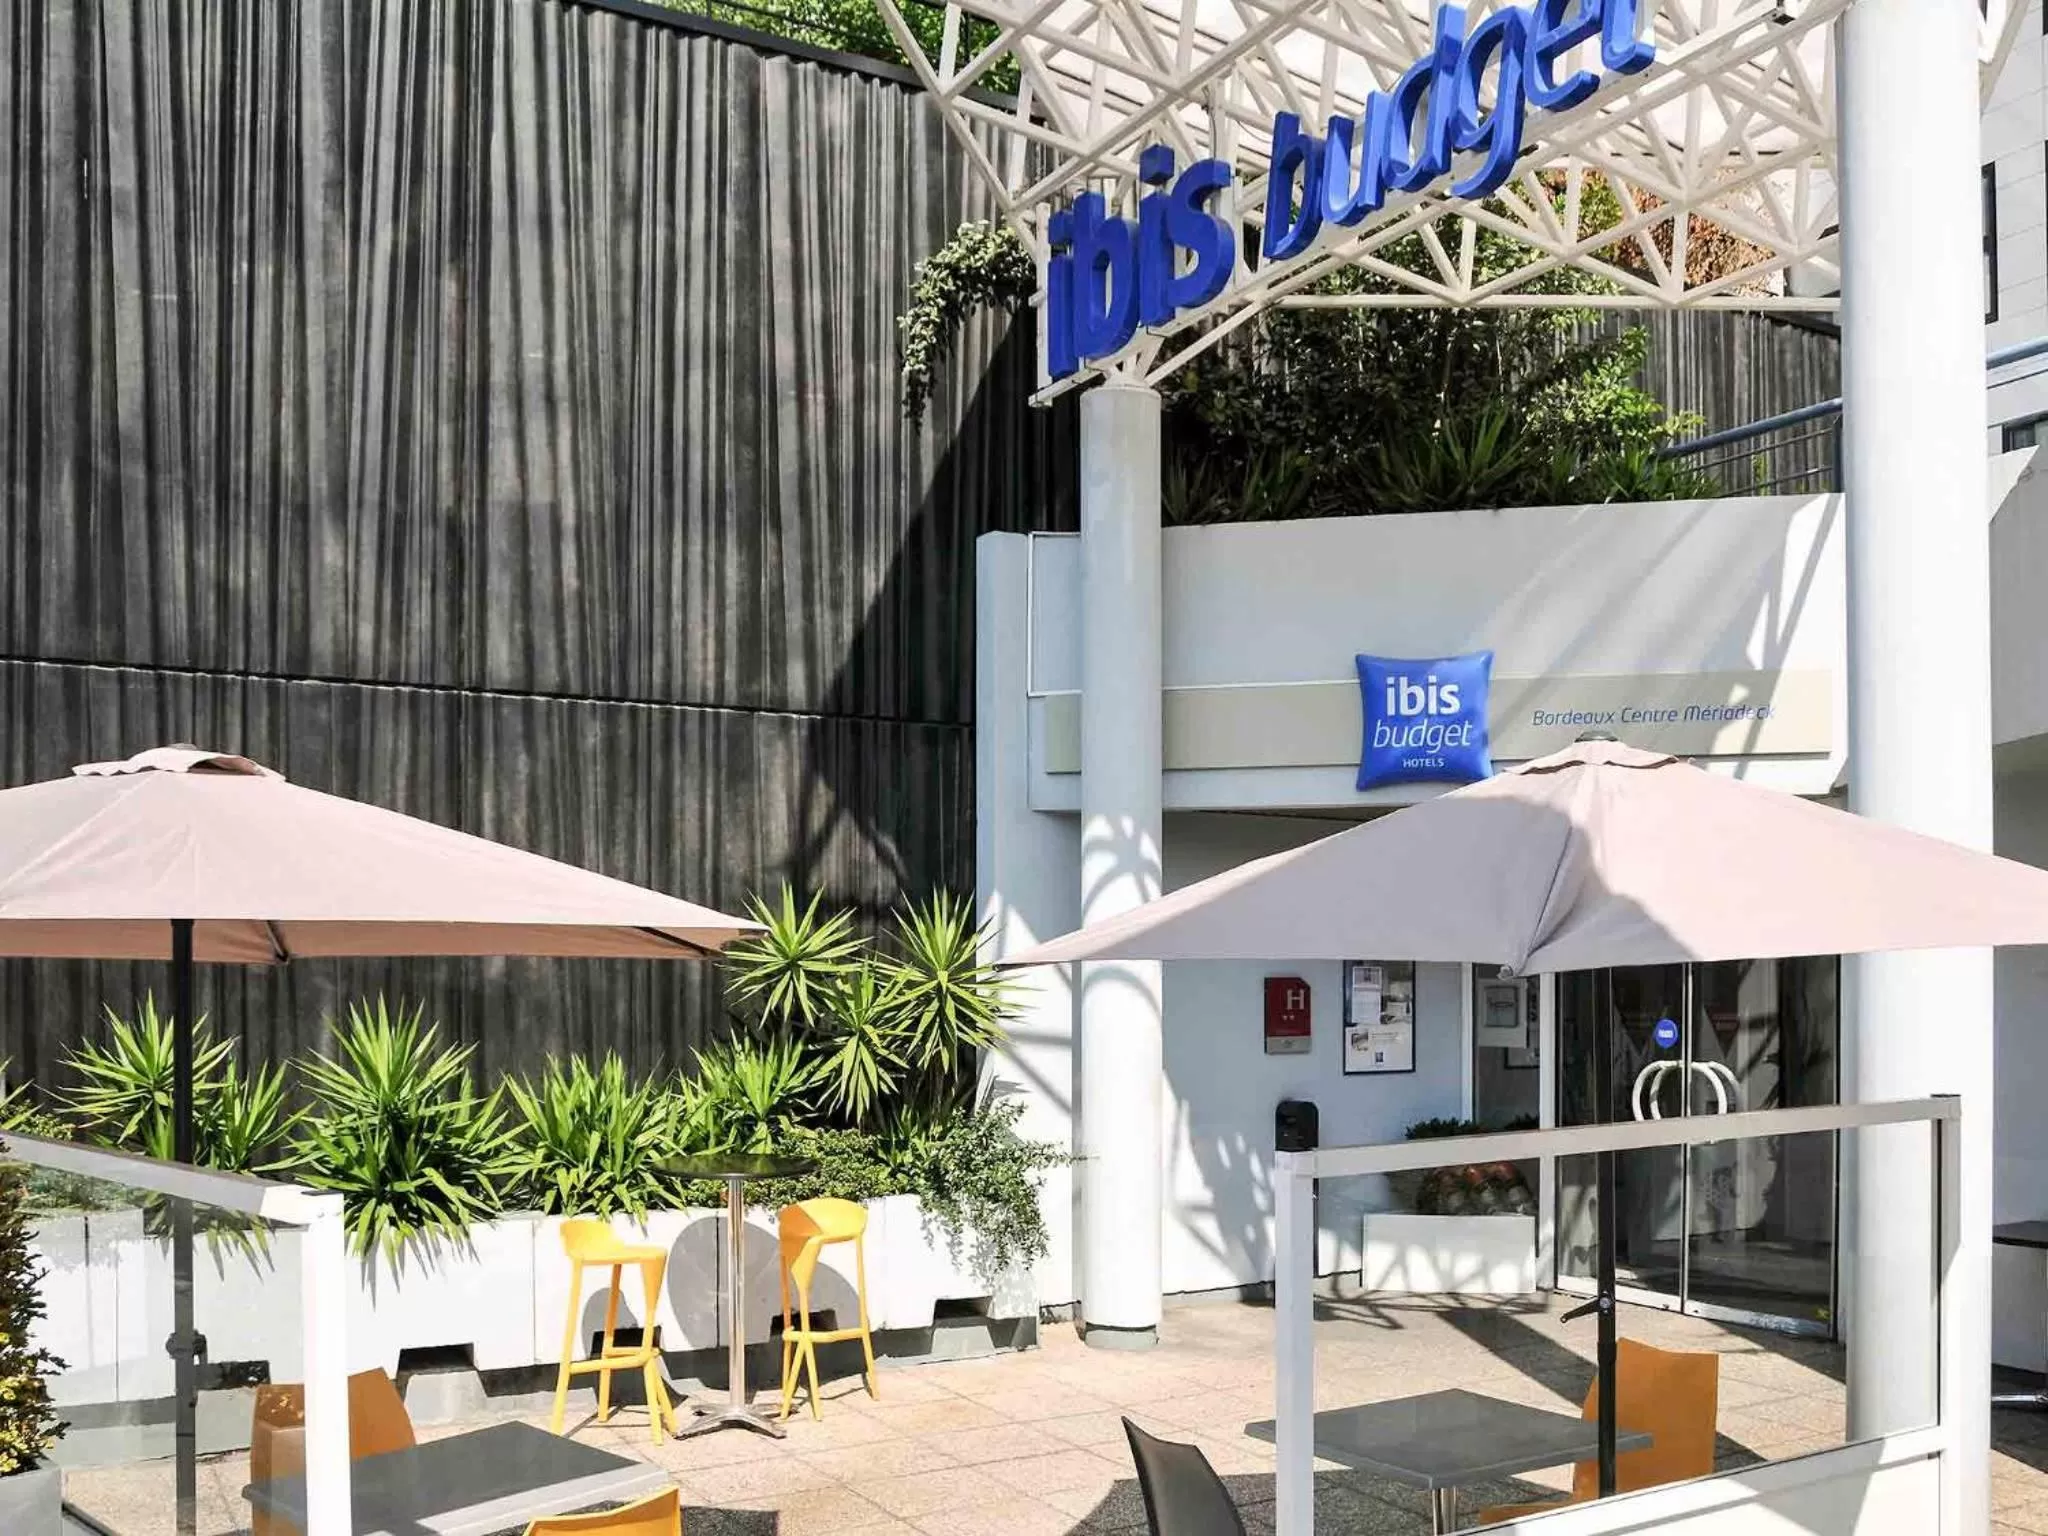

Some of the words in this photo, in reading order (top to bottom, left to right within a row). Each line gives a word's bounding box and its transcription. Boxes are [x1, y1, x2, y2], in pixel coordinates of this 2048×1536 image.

[1048, 144, 1236, 378] ibis
[1386, 675, 1461, 716] ibis
[1532, 708, 1615, 726] Bordeaux
[1621, 706, 1679, 723] Centre
[1373, 718, 1473, 754] budget
[1402, 758, 1445, 768] HOTELS
[1287, 989, 1305, 1010] H
